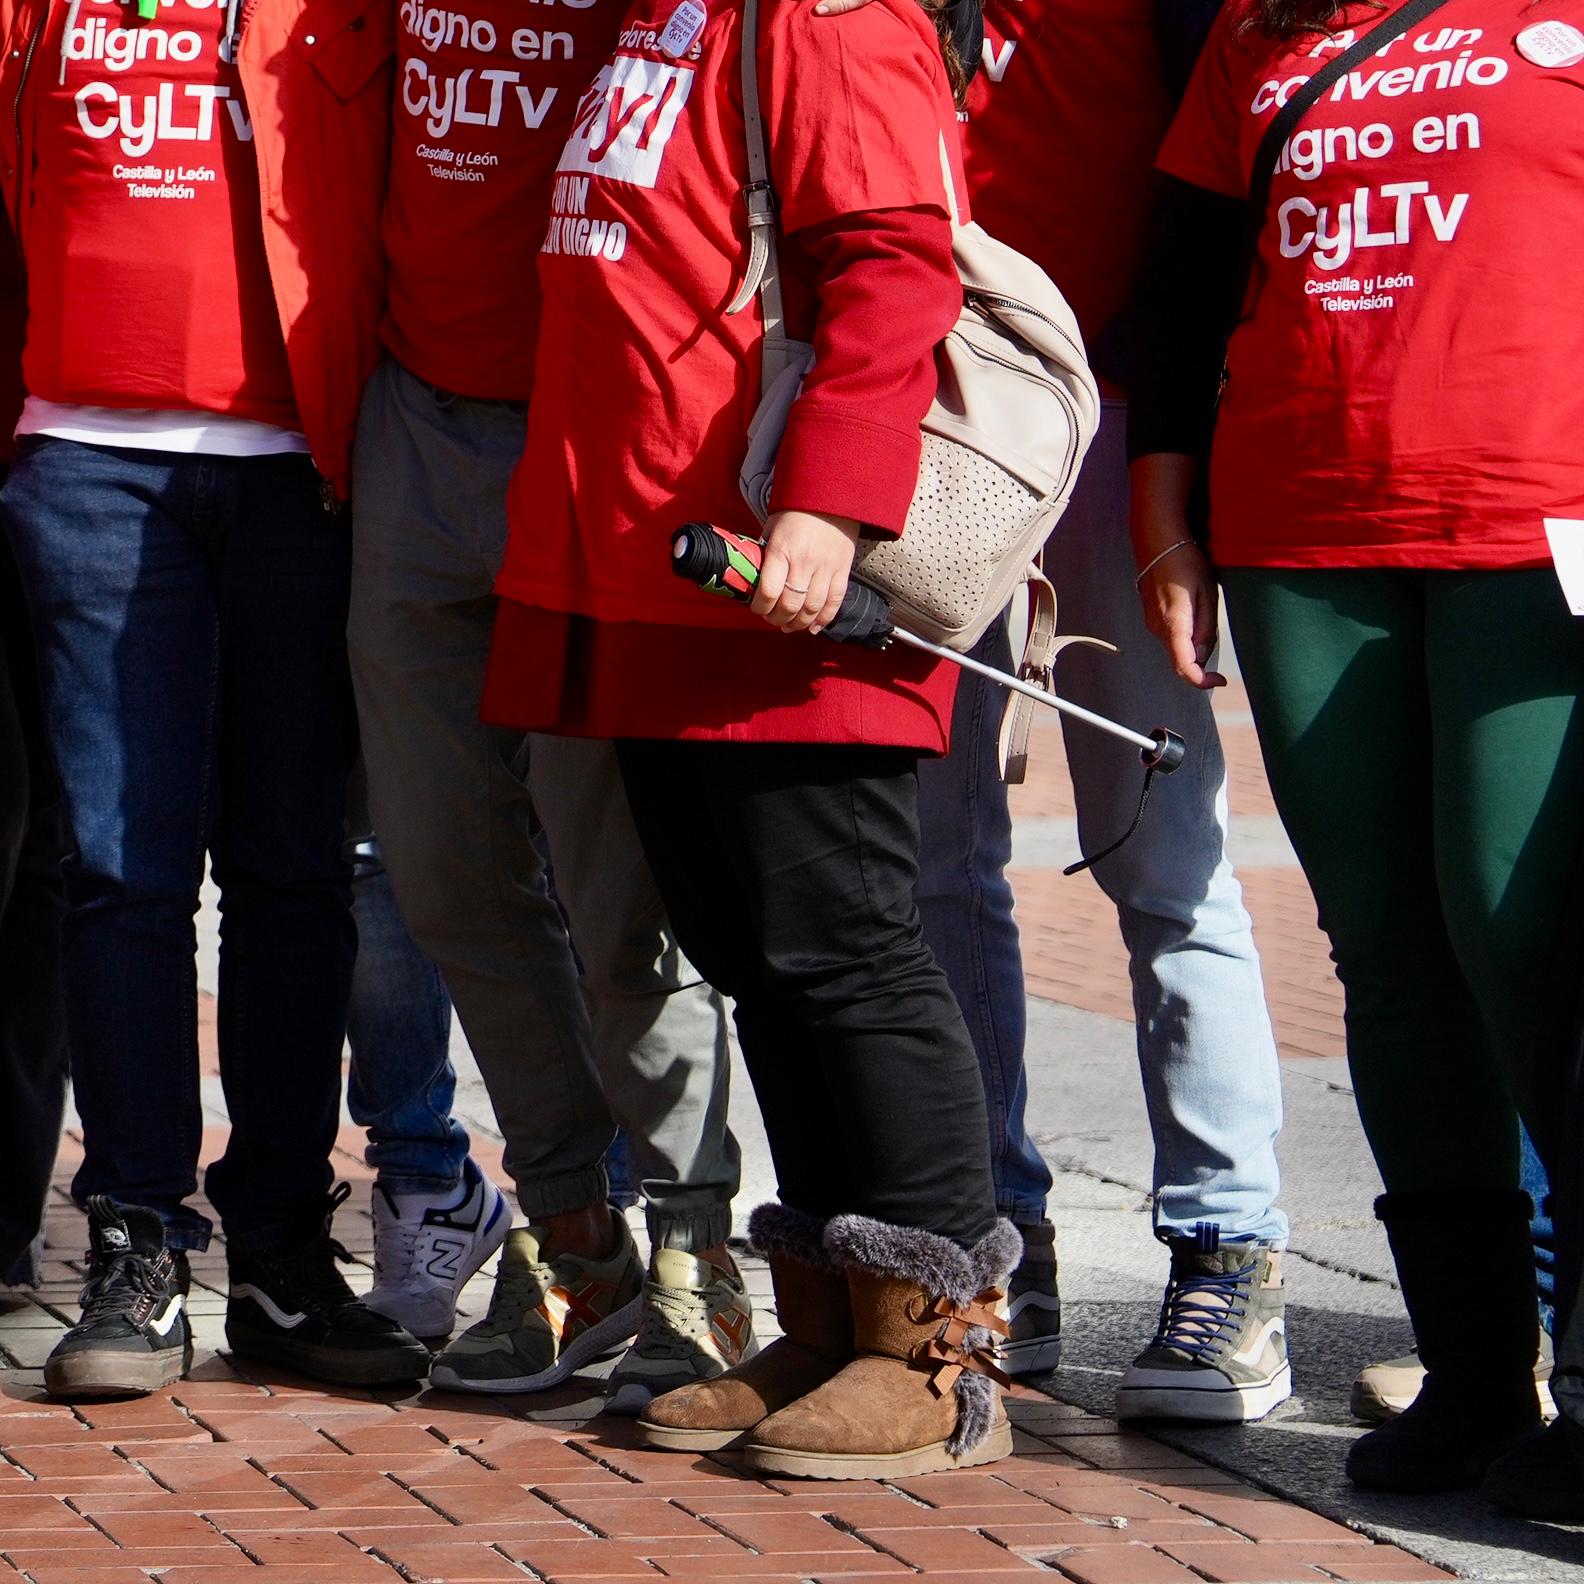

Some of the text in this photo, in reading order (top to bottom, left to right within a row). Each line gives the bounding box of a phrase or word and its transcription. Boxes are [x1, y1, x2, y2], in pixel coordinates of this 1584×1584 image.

[67, 18, 202, 72] digno
[512, 27, 574, 61] en
[1309, 27, 1483, 58] Pr un
[402, 56, 558, 138] CyLTv
[416, 143, 498, 166] Castilla y León
[1273, 111, 1481, 181] igno en
[112, 164, 215, 183] Castilla y León
[427, 163, 485, 182] Televisión
[127, 183, 195, 199] Televisión
[1278, 180, 1470, 271] CyLTv
[1304, 273, 1414, 295] Castilla y León
[1321, 293, 1393, 312] Televisión
